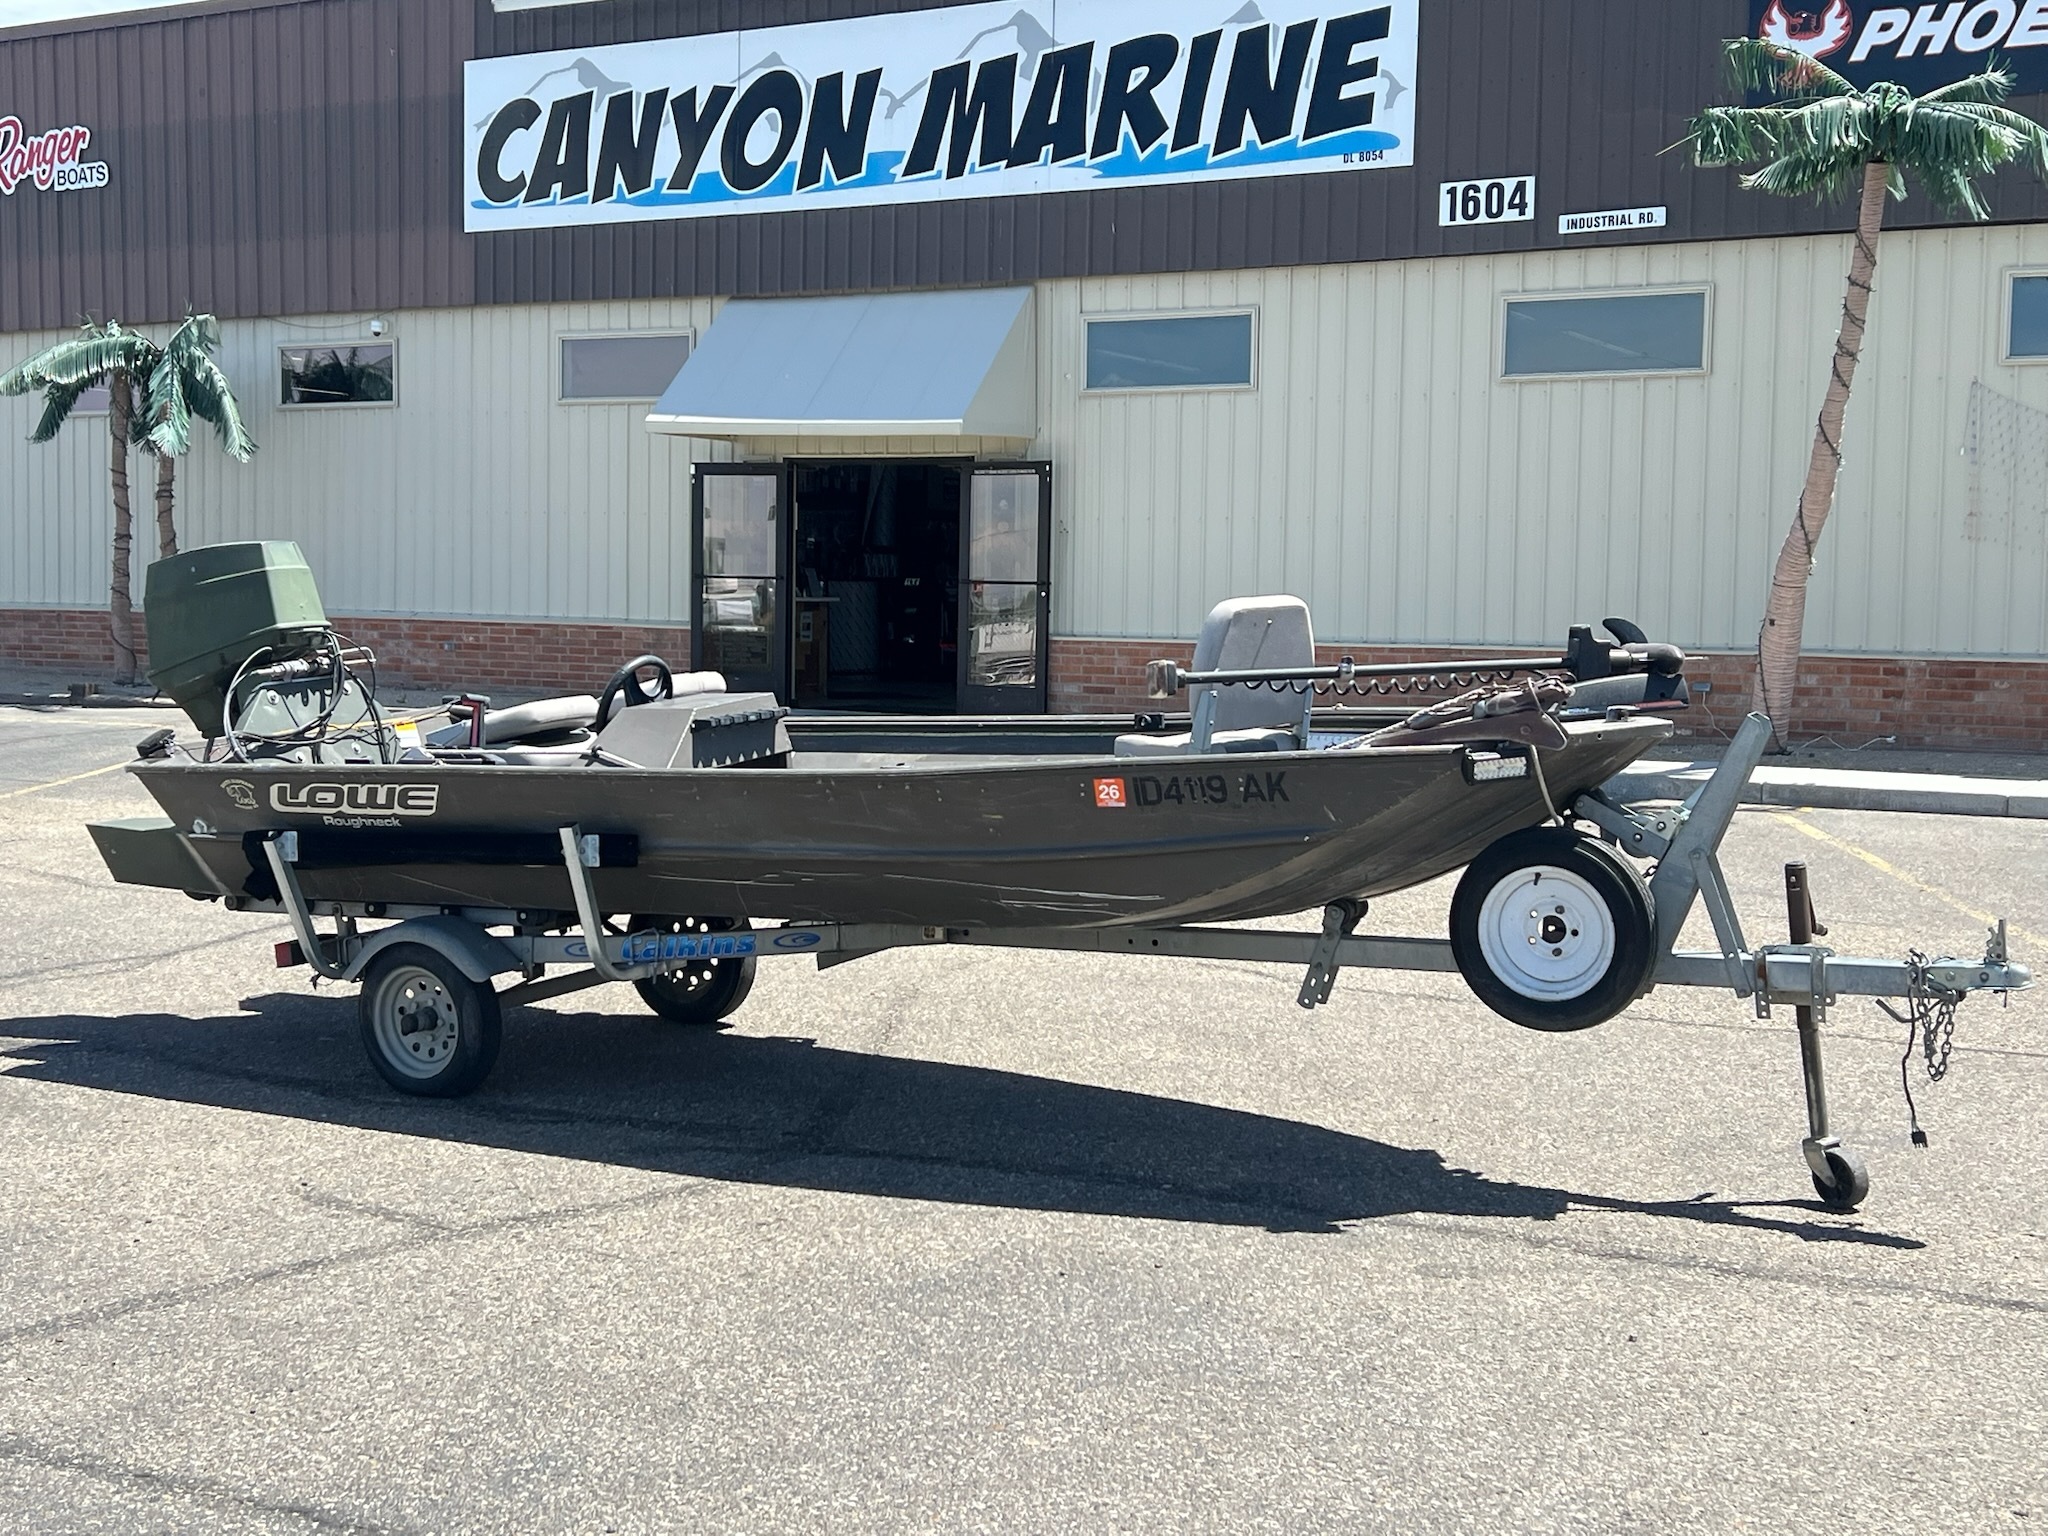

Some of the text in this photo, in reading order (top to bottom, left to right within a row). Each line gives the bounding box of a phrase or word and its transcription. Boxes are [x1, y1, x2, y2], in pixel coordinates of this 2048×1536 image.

[476, 5, 1393, 205] CANYON MARINE
[1343, 149, 1384, 164] DL 8054
[57, 164, 106, 186] BOATS
[1446, 180, 1528, 222] 1604
[1566, 213, 1633, 231] INDUSTRIAL
[1098, 784, 1120, 799] 26
[1243, 770, 1290, 803] AK
[269, 783, 439, 816] LOWE
[323, 815, 402, 829] Roughneck
[621, 934, 756, 960] Calkins
